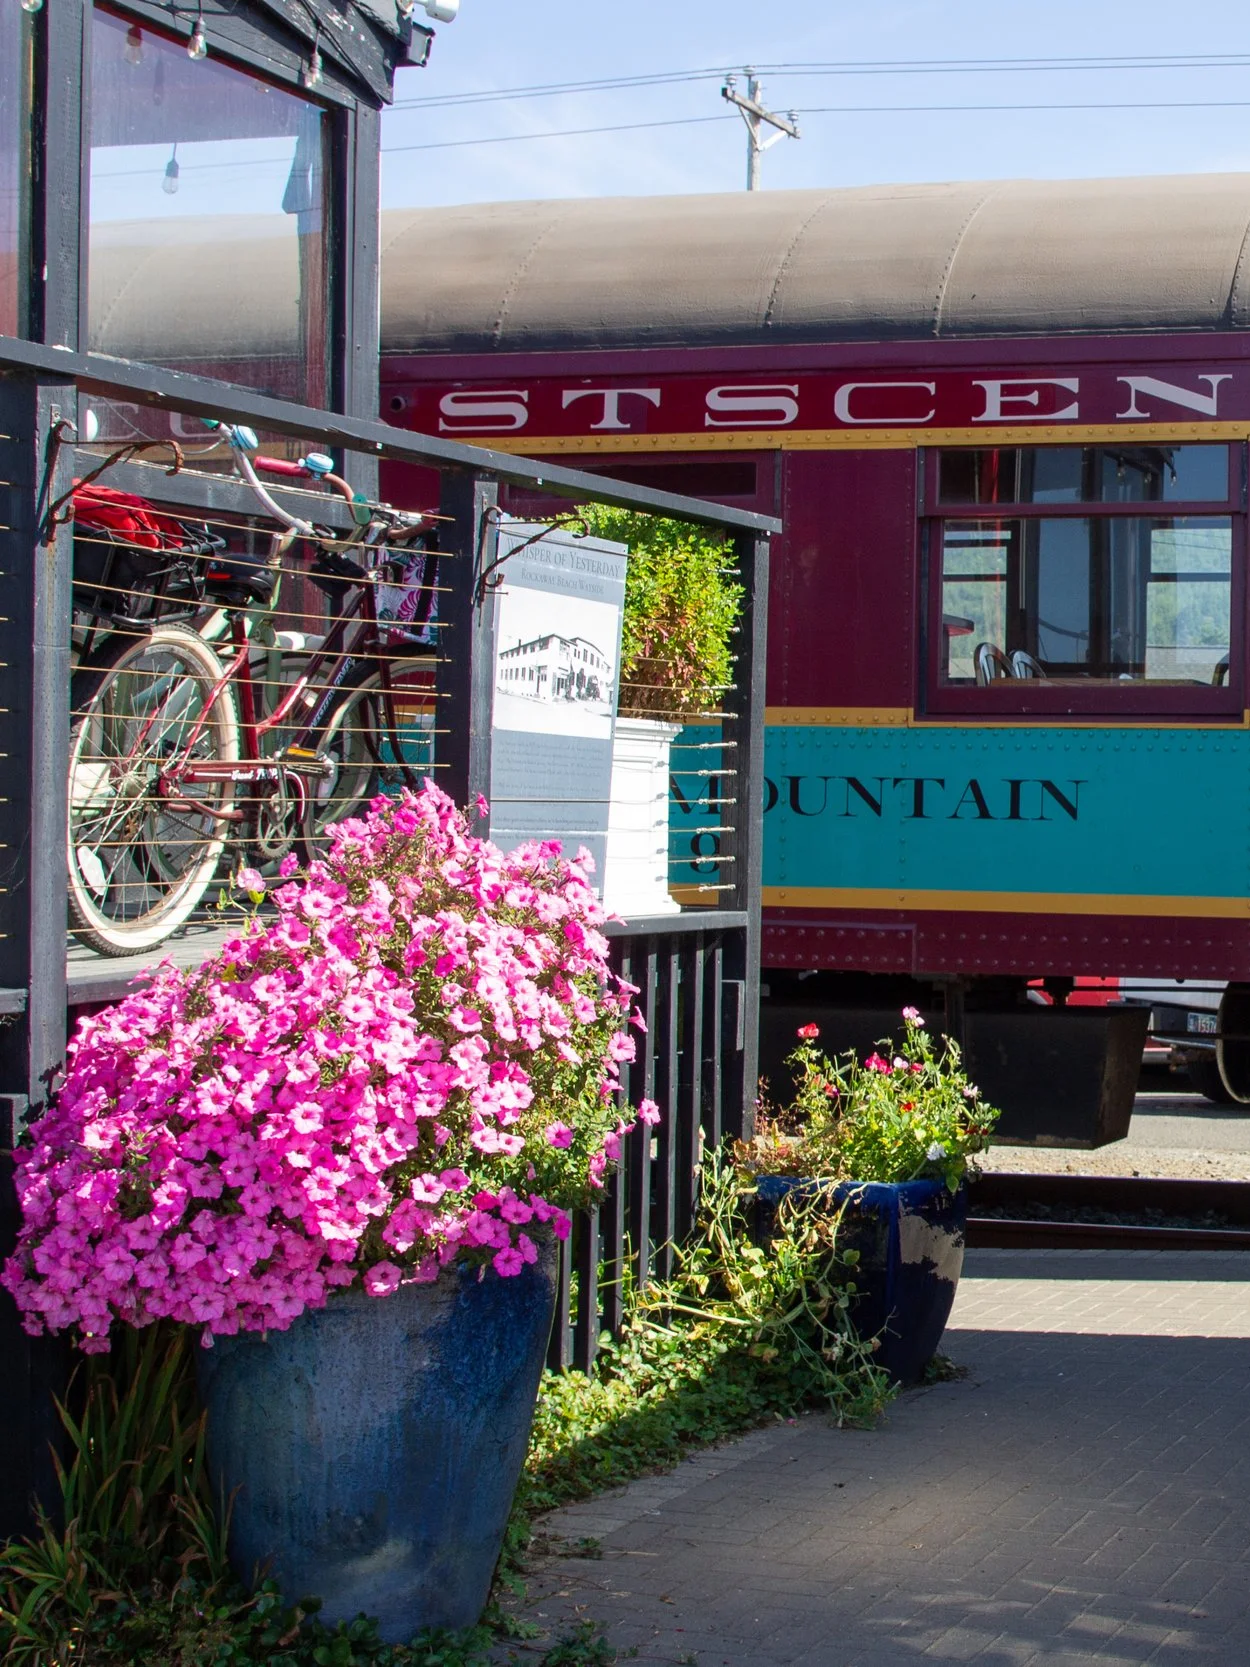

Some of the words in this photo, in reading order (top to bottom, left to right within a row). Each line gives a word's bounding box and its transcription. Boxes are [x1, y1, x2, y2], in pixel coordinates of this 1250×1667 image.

[554, 551, 568, 567] OF
[569, 550, 620, 578] YESTERDAY
[521, 567, 555, 585] ROCKAWAY
[557, 575, 578, 590] BEACH
[579, 579, 605, 595] WAYSIDE
[669, 774, 1088, 821] MUNTAIN
